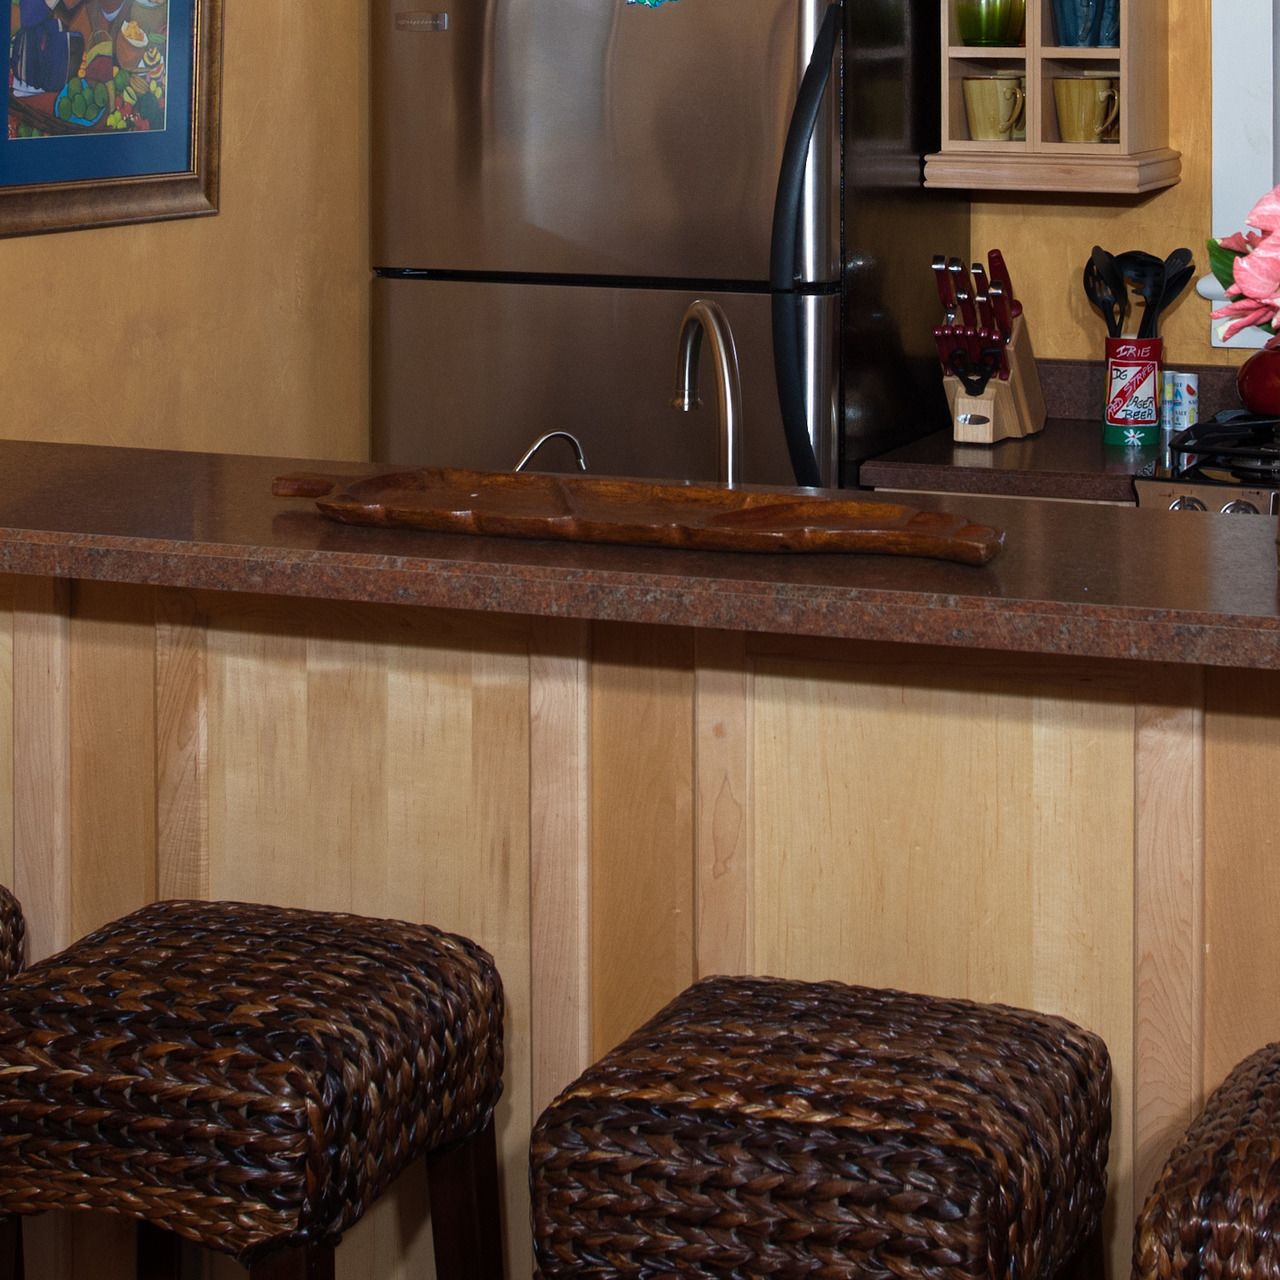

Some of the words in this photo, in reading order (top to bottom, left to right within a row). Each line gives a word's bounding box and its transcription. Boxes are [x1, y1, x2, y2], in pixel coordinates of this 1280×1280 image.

[1115, 345, 1152, 358] IRIE
[1107, 397, 1124, 416] RED
[1123, 361, 1154, 397] STRIPE
[1126, 395, 1154, 409] LAGER
[1122, 408, 1154, 420] BEER
